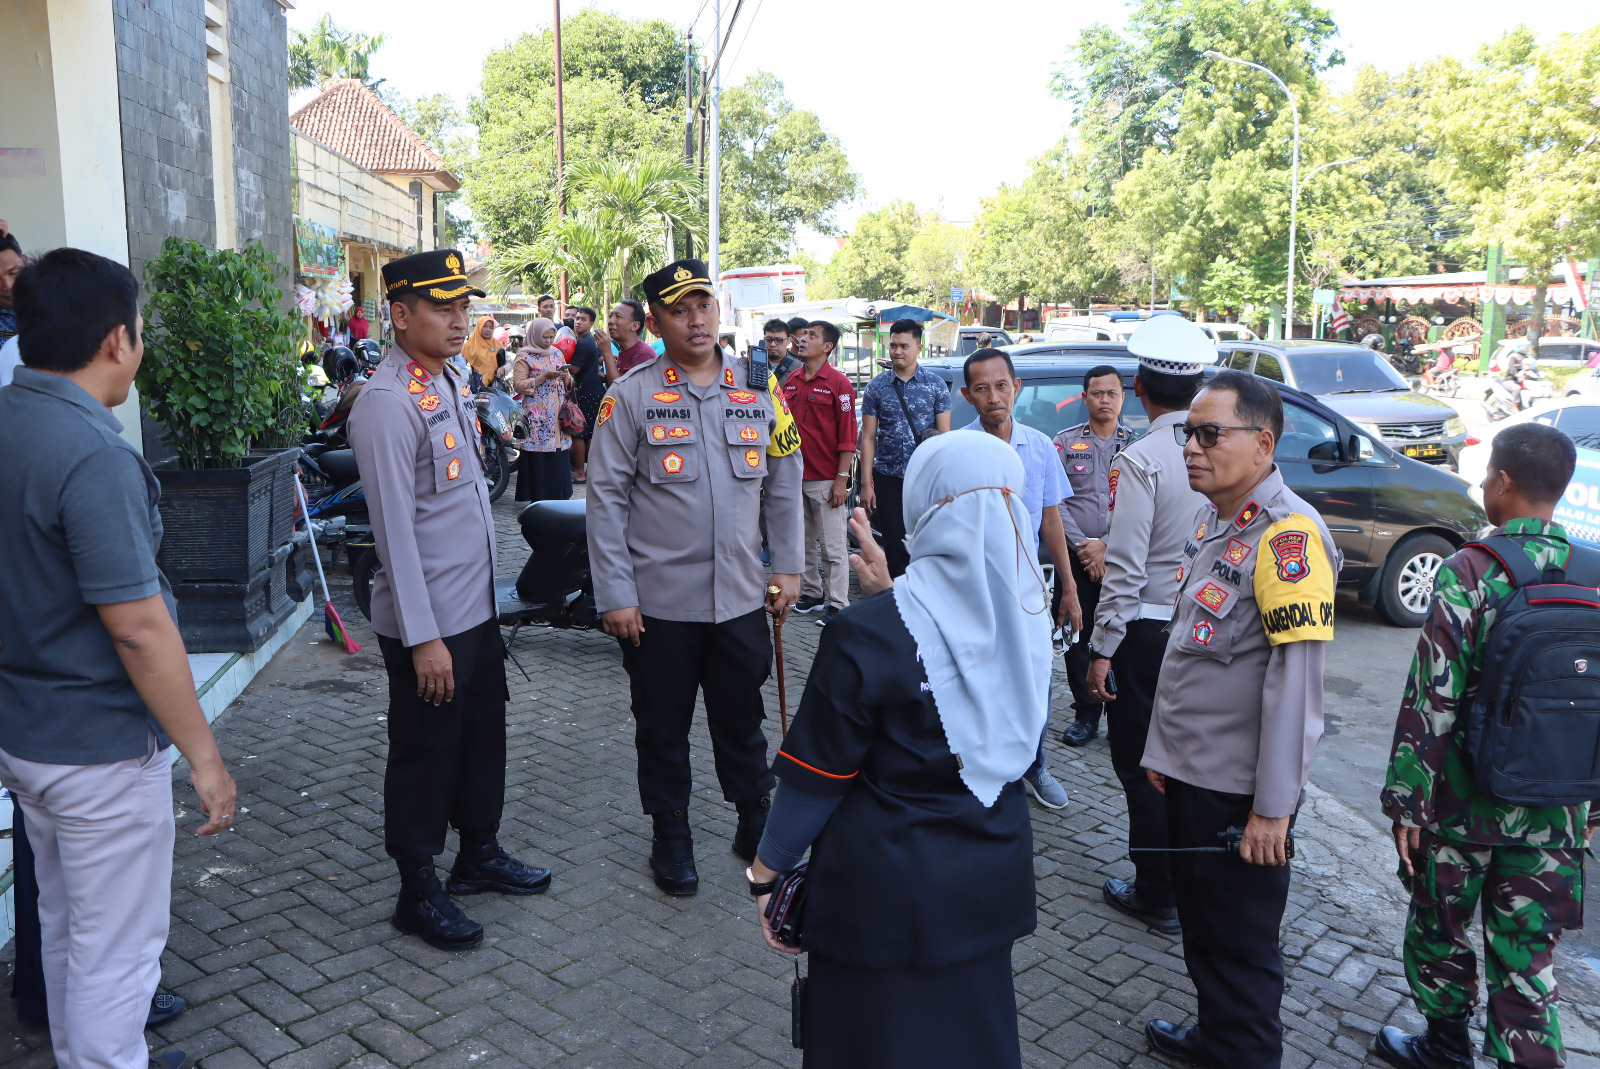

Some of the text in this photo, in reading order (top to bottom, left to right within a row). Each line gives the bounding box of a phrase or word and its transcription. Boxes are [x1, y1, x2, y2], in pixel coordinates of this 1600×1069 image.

[427, 409, 450, 427] HARYANTO
[646, 408, 691, 420] DWIASI
[725, 408, 766, 419] POLRI
[1274, 535, 1302, 546] POLRES
[1212, 560, 1241, 586] POLRI
[1262, 602, 1316, 634] KARENDAL
